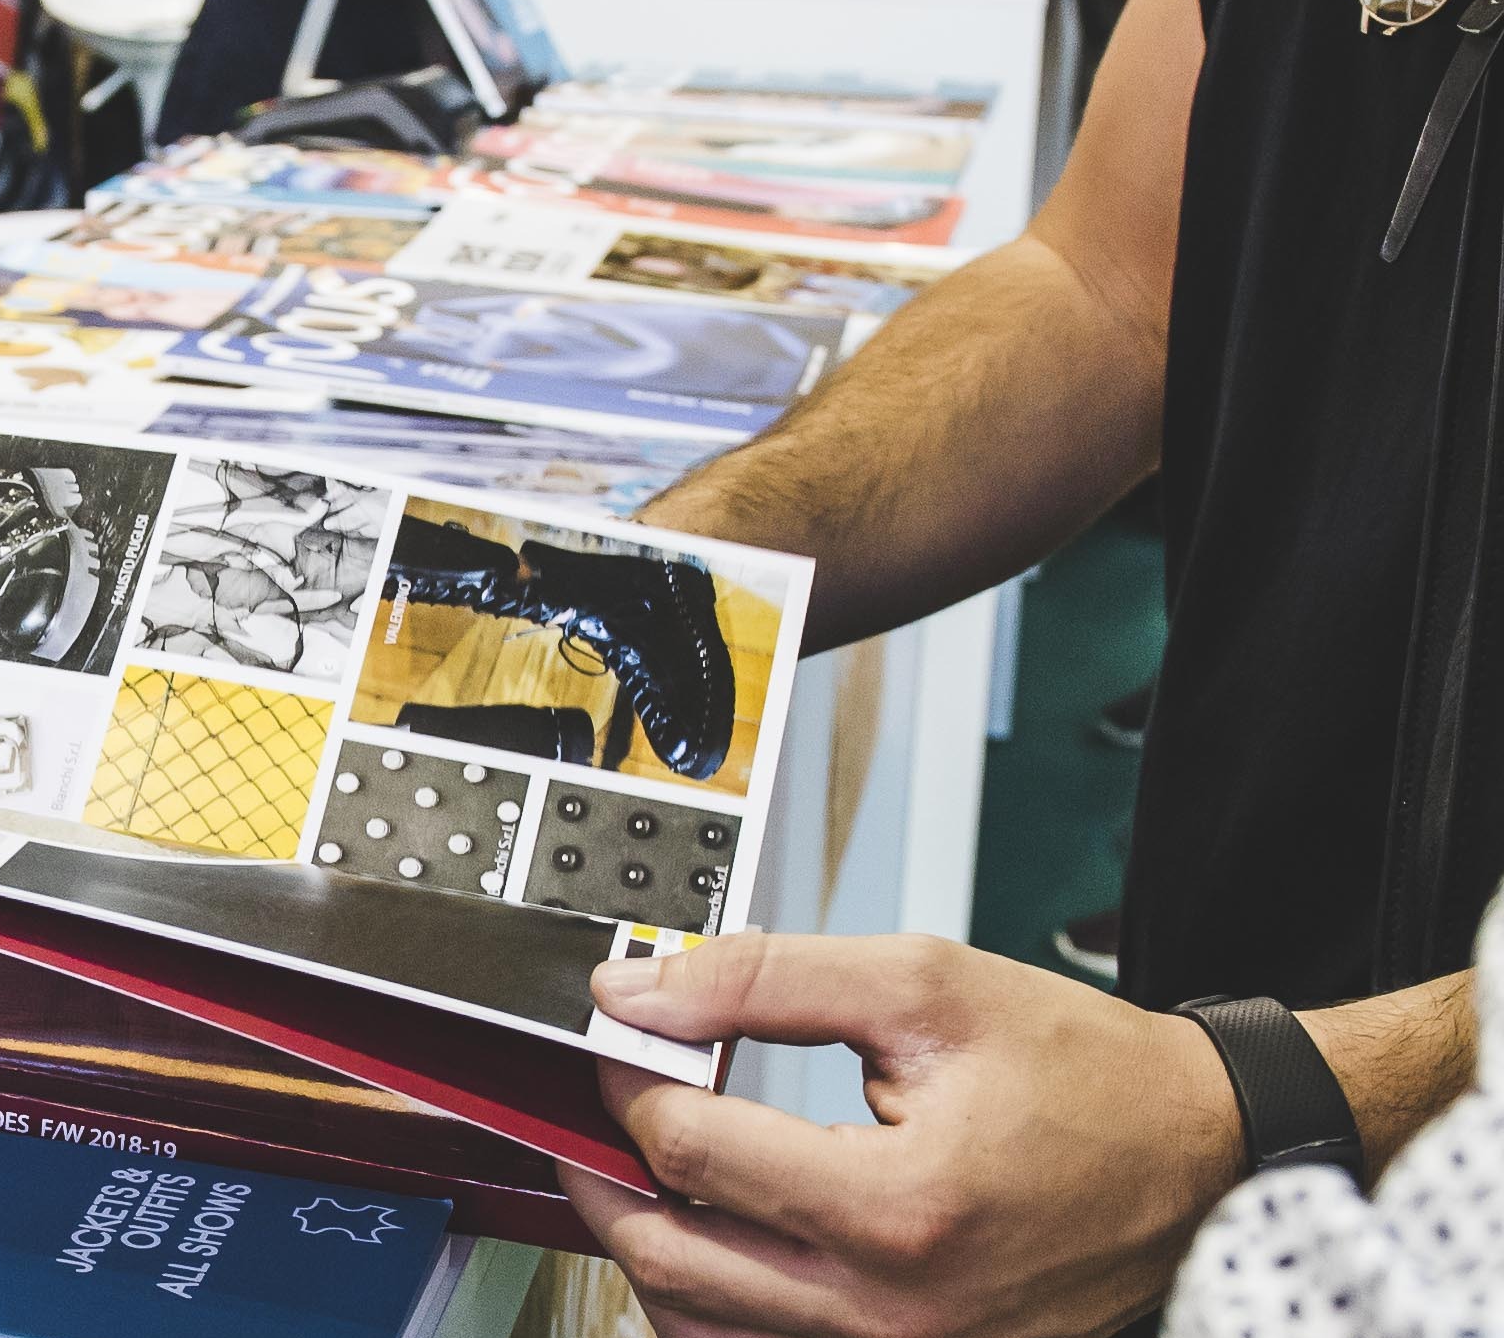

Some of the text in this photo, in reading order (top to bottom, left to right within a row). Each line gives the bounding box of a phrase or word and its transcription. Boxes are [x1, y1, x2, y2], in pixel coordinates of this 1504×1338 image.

[40, 1117, 86, 1143] F/W
[88, 1127, 178, 1159] 2018-19
[55, 1166, 154, 1274] JACKETS &
[120, 1172, 197, 1250] OUTFITS
[155, 1181, 253, 1300] ALL SHOWS
